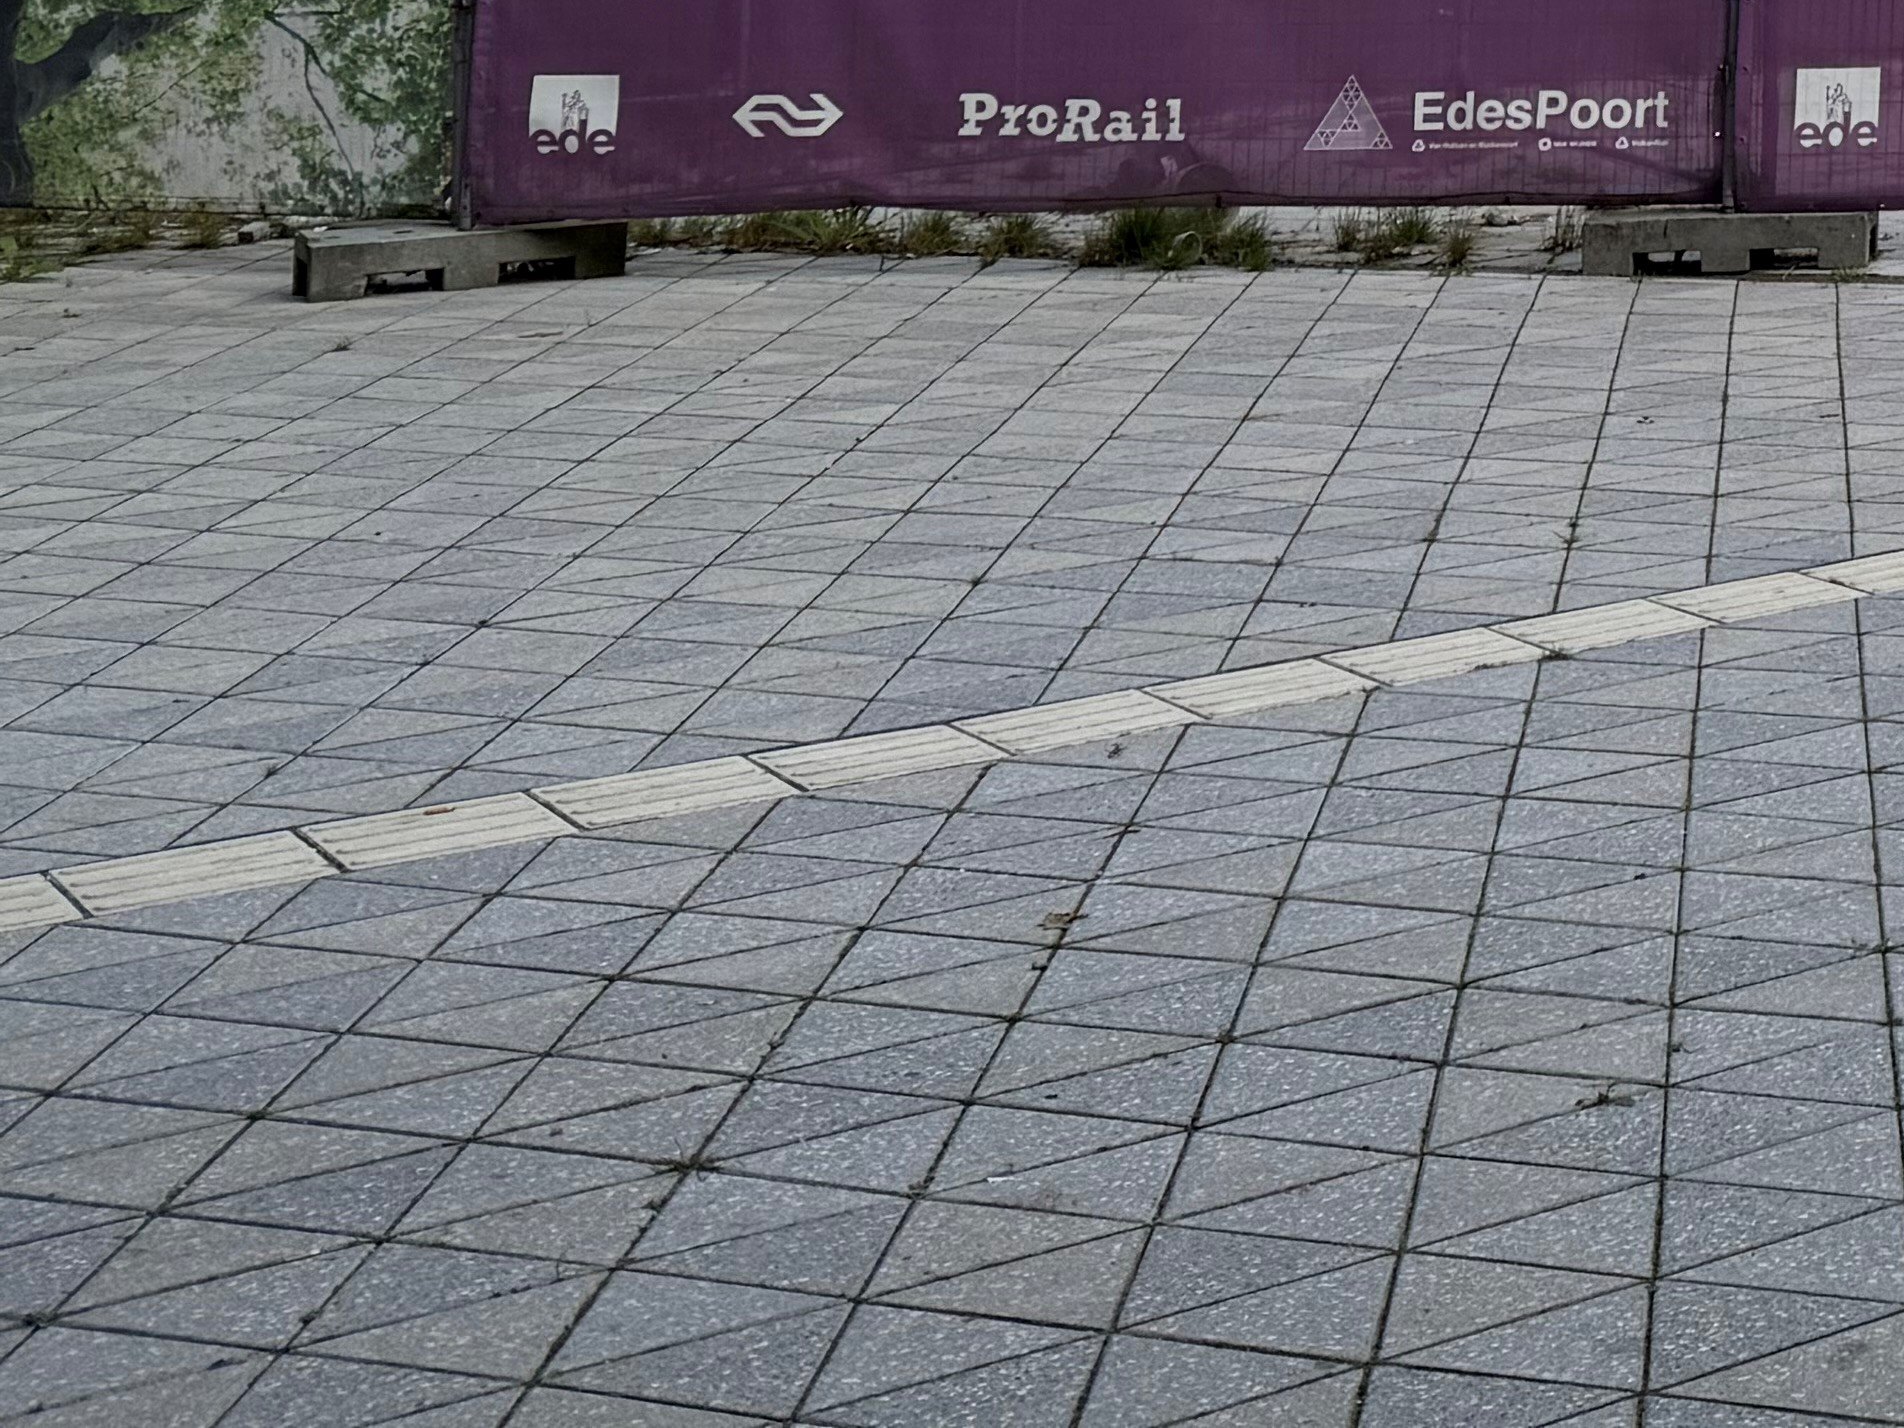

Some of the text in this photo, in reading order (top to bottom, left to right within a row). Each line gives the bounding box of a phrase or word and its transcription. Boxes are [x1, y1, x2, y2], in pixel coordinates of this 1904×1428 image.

[958, 93, 1186, 144] ProRail
[1413, 89, 1669, 132] EdesPoort
[1794, 110, 1878, 151] ede
[529, 117, 618, 157] ede
